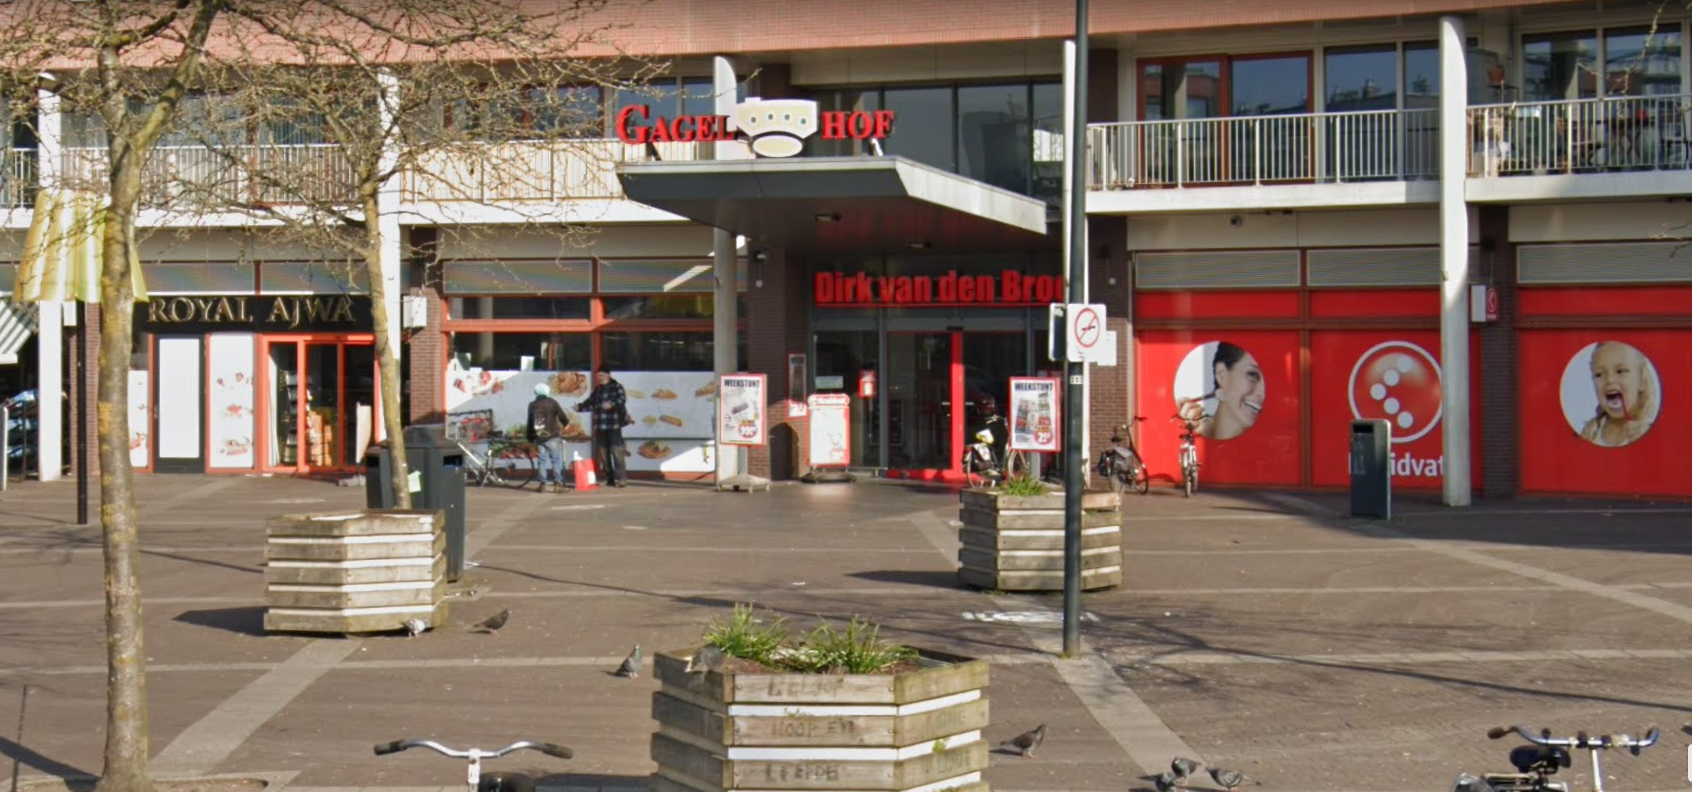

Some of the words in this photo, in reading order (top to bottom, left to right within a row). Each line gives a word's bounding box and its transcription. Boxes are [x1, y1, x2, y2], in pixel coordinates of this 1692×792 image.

[615, 104, 736, 145] GAGEL
[821, 110, 894, 140] HOF
[815, 271, 873, 303] Dirk
[879, 275, 932, 303] van
[938, 270, 995, 303] den
[1001, 270, 1065, 303] Bro
[147, 297, 254, 323] ROYAL
[266, 297, 357, 330] AJWA
[723, 379, 760, 388] WEEKSTUNT
[1014, 382, 1054, 392] WEEKSTUNT
